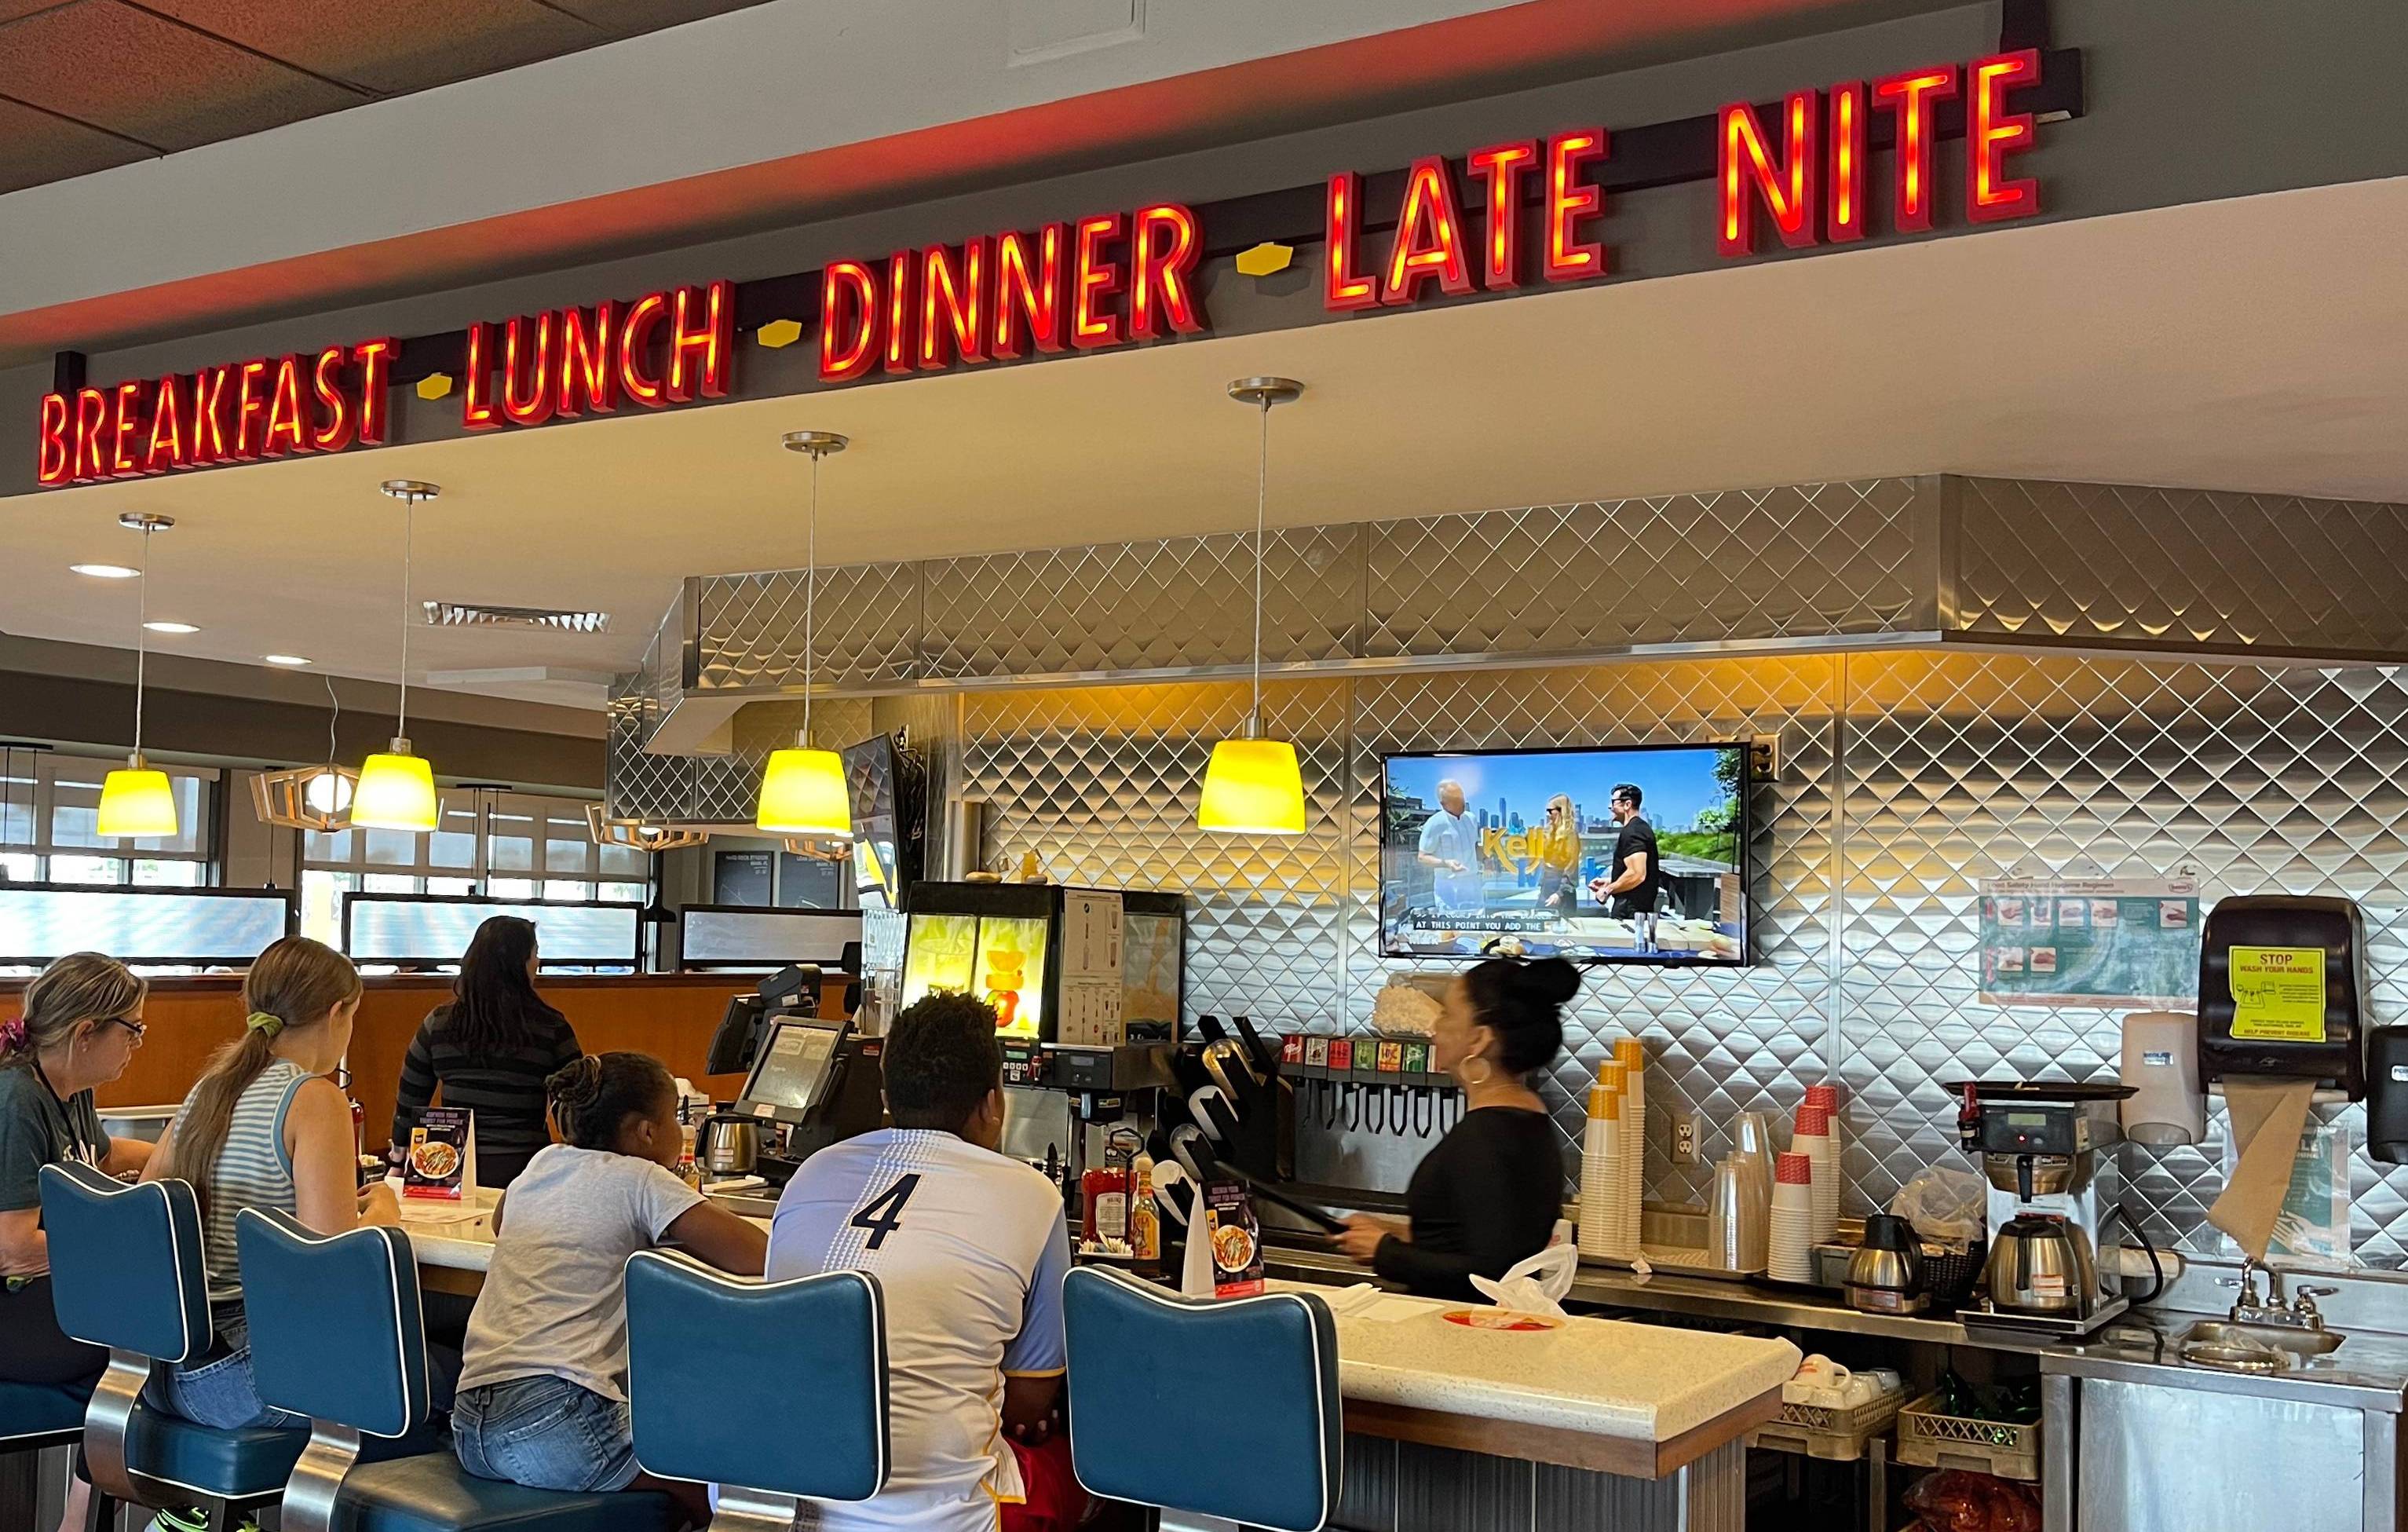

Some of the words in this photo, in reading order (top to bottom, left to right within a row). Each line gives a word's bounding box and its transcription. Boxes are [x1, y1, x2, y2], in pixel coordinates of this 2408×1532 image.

[38, 337, 401, 488] BREAKFAST
[462, 280, 735, 432] LUNCH
[818, 202, 1203, 382] DINNER
[1325, 126, 1608, 313] LATE
[1716, 48, 2040, 258] NITE
[1416, 921, 1427, 930] AT
[1431, 921, 1451, 930] THIS
[1485, 922, 1501, 931] YOU
[1504, 922, 1522, 931] ADD
[2260, 953, 2293, 965] STOP
[2240, 964, 2262, 973] WASH
[850, 1173, 922, 1250] 4
